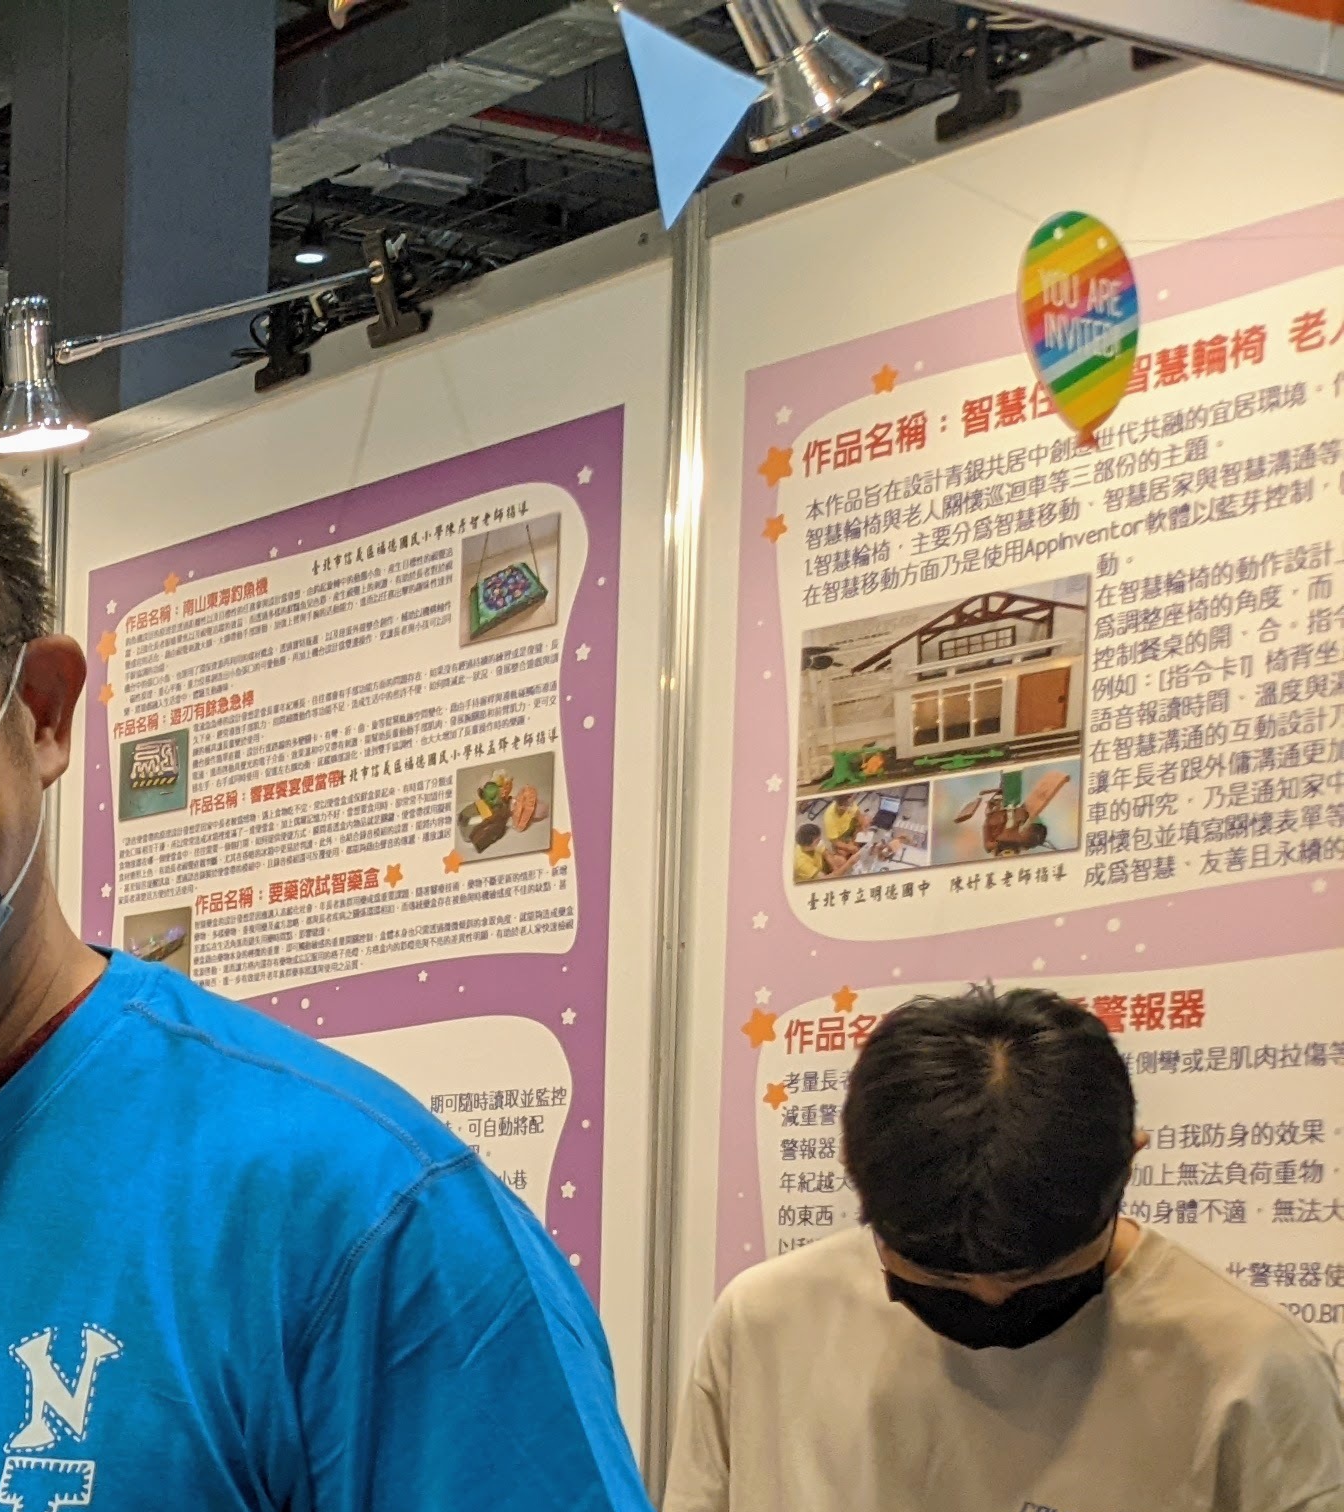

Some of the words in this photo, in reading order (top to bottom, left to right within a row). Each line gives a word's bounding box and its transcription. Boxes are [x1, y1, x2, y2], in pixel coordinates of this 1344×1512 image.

[1096, 540, 1344, 609] 在智慧輪椅的動作設計
[1066, 988, 1206, 1034] 警報器
[446, 1115, 544, 1138] ，可自動將配
